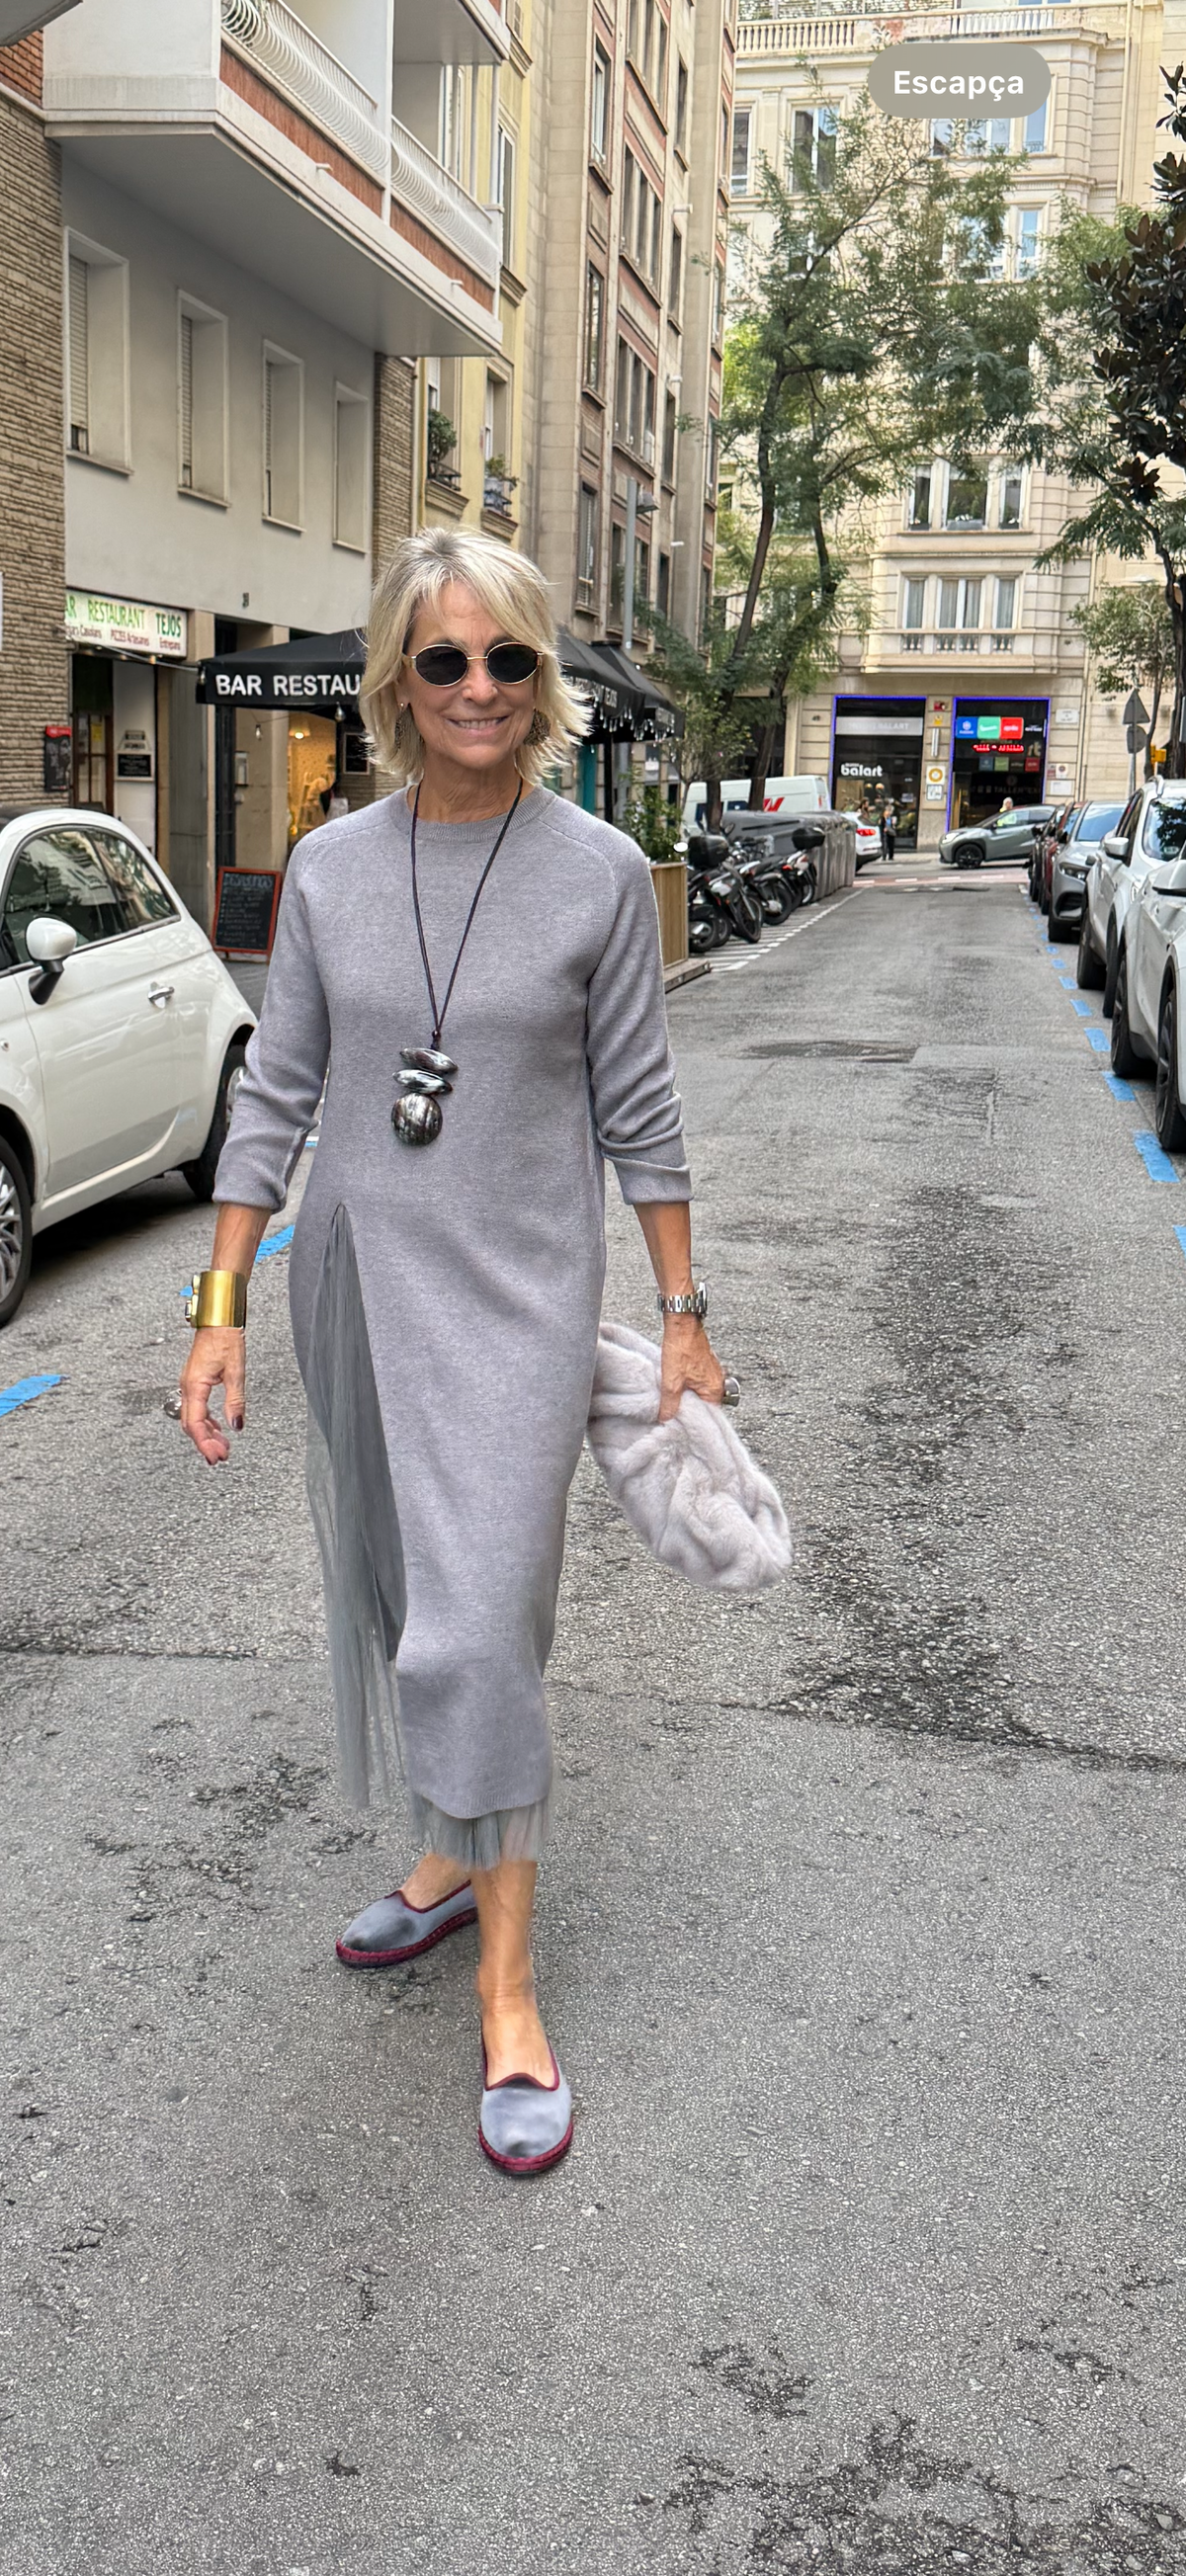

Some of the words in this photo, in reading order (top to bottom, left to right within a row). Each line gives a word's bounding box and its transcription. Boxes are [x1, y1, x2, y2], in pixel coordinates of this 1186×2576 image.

[87, 599, 145, 629] RESTAURANT
[155, 613, 182, 637] TEJOS
[214, 674, 262, 696] BAR
[273, 674, 361, 697] RESTAU
[840, 764, 884, 778] balart
